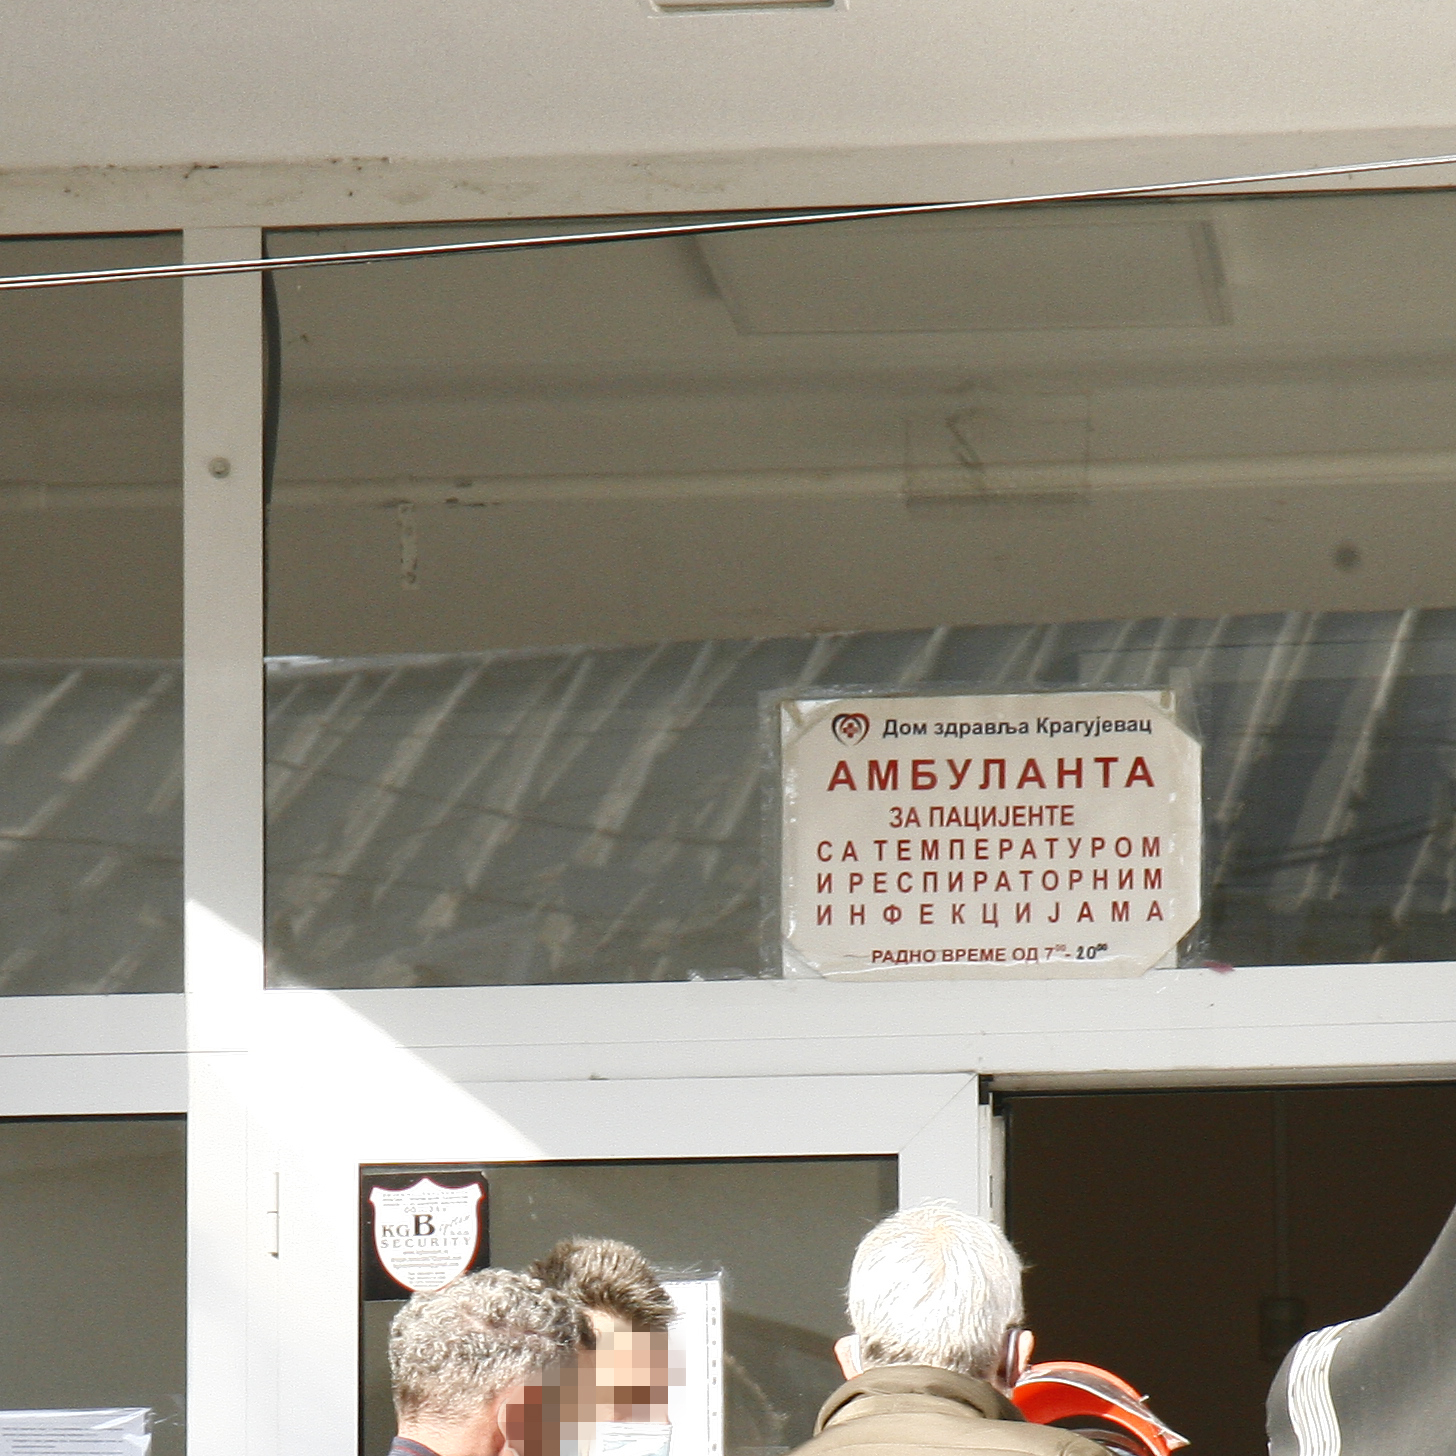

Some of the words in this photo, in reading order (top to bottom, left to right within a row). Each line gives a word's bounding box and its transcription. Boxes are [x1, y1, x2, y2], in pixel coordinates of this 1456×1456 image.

[883, 718, 927, 738] Дом
[934, 721, 1030, 740] здравља
[1036, 716, 1153, 739] Крагујевац
[827, 756, 1155, 791] АМБУЛАНТА
[889, 806, 921, 829] ЗА
[929, 805, 1075, 831] ПАЦИЈЕНТЕ
[817, 840, 859, 863] СА
[873, 836, 1161, 862] ТЕМПЕРАТУРОМ
[817, 872, 832, 895] И
[849, 868, 1163, 894] РЕСПИРАТОРНИМ
[817, 900, 1164, 928] ИНФЕКЦИЈАМА
[872, 949, 937, 964] РАДНО
[941, 948, 1006, 962] ВРЕМЕ
[1012, 947, 1039, 964] ОД
[380, 1237, 471, 1249] SECURITY
